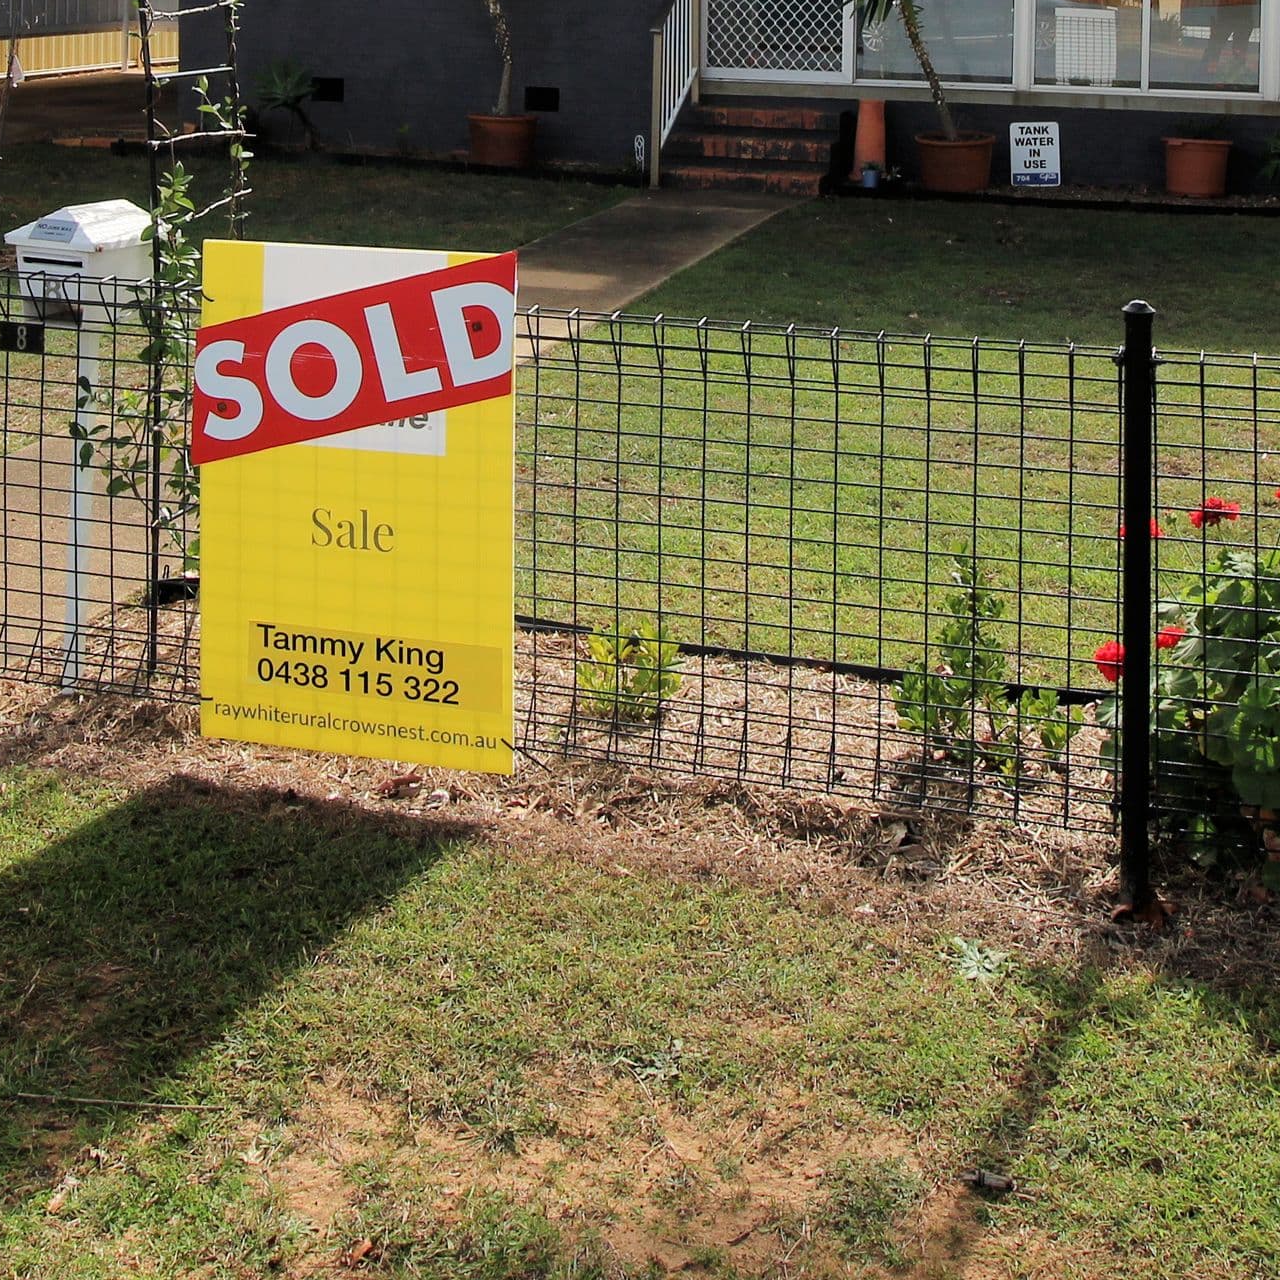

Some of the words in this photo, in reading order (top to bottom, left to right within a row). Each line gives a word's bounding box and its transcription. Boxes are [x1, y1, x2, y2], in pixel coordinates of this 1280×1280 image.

[1015, 137, 1054, 147] WATER
[1019, 126, 1049, 135] TANK
[1024, 159, 1047, 169] USE
[1029, 148, 1041, 158] IN
[44, 276, 62, 299] 8
[16, 325, 28, 350] 8
[195, 282, 515, 441] SOLD
[310, 508, 395, 553] Sale
[256, 623, 364, 665] Tammy
[375, 637, 445, 675] King
[256, 657, 329, 689] 0438
[339, 668, 393, 697] 115
[403, 675, 460, 706] 322
[214, 701, 498, 751] raywhiteruralcrowsnest.com.au
